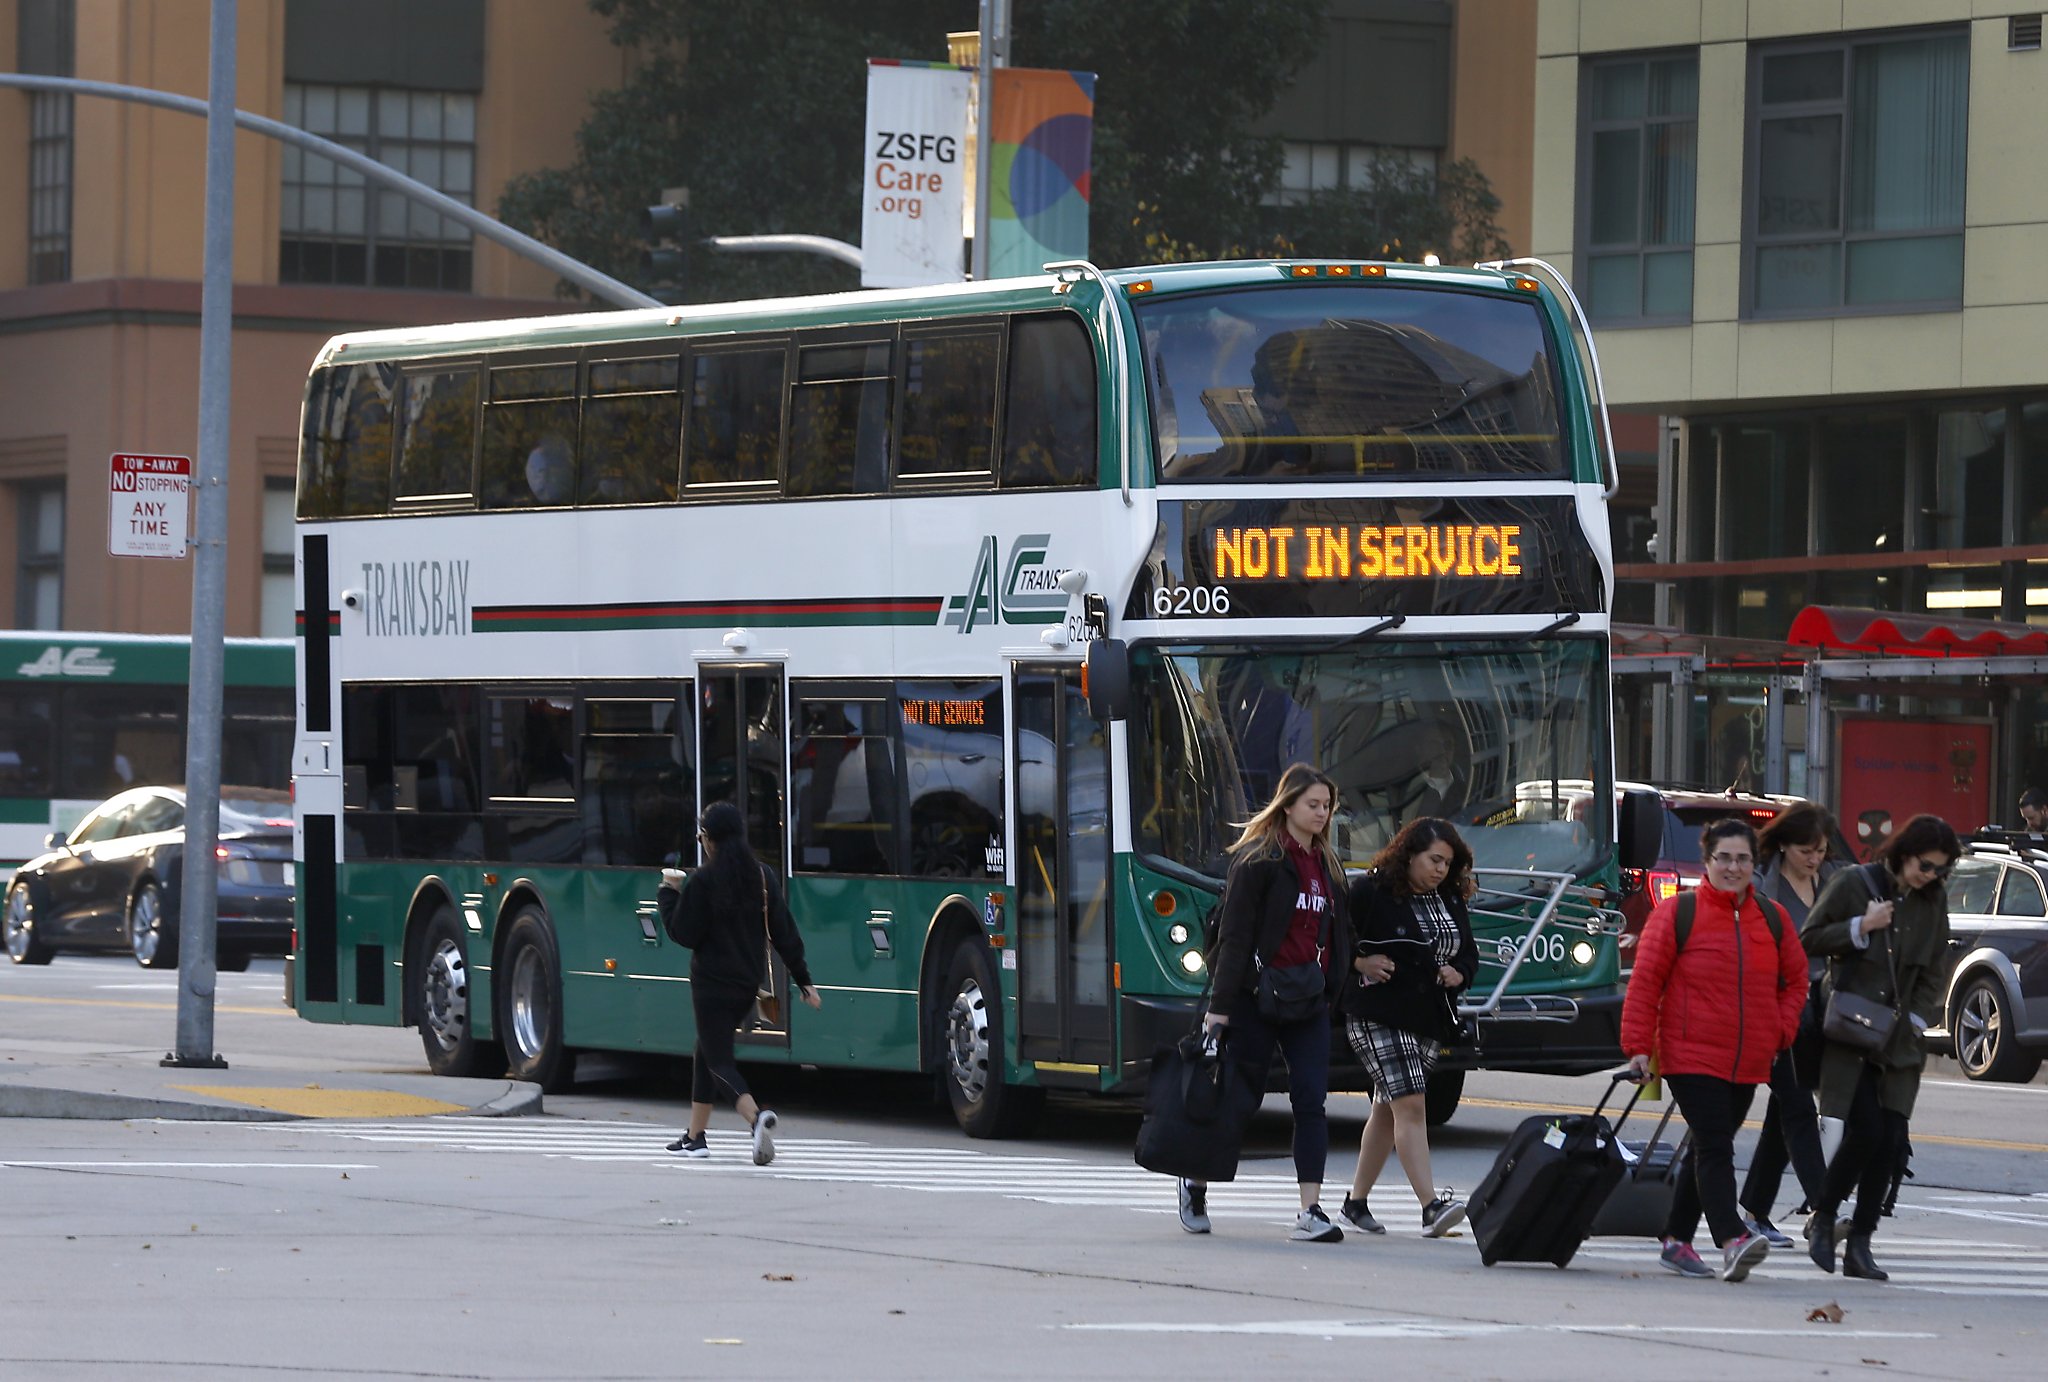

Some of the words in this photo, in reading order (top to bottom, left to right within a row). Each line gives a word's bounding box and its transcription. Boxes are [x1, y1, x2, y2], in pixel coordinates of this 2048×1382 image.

[876, 132, 956, 163] ZSFG
[875, 162, 943, 193] Care
[874, 197, 922, 219] .org
[123, 458, 180, 472] TOW-AWAY
[113, 471, 135, 491] NO
[137, 477, 188, 493] STOPPING
[133, 501, 166, 516] ANY
[130, 520, 169, 536] TIME
[1216, 528, 1294, 578] NOT
[1306, 527, 1348, 578] IN
[1361, 525, 1521, 577] SERVICE
[944, 533, 1071, 634] AC
[362, 560, 469, 637] TRANSBAY
[1153, 586, 1230, 615] 6206
[903, 700, 925, 725] NOT
[928, 700, 941, 725] IN
[944, 700, 984, 725] SERVICE
